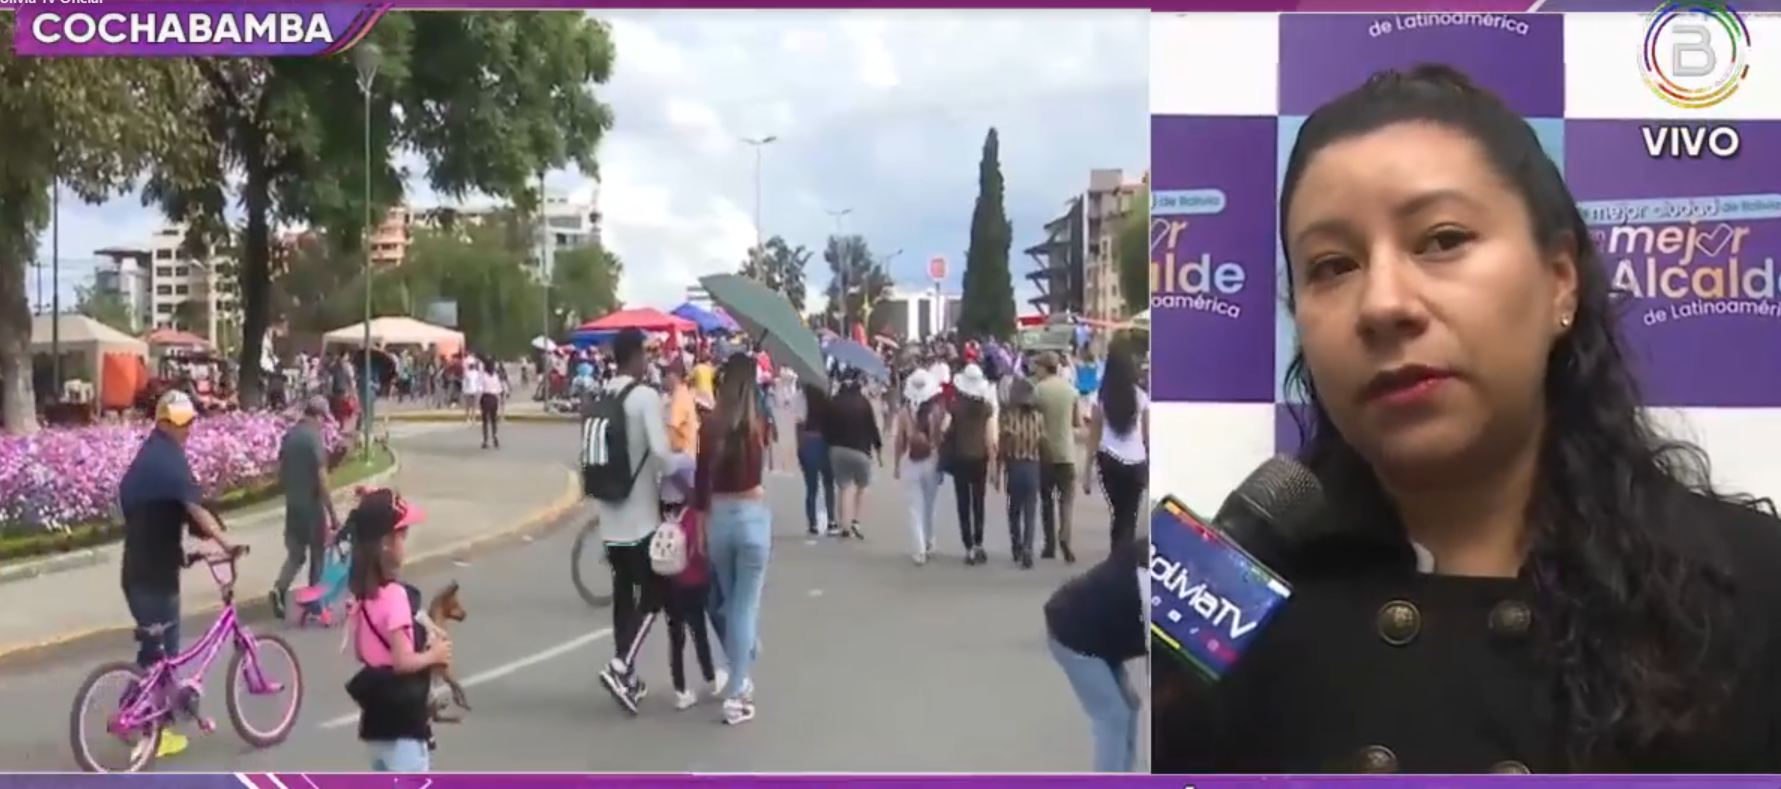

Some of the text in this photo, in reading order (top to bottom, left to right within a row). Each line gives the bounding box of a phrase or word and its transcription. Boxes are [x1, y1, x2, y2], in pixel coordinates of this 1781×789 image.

[1369, 20, 1392, 37] de
[1608, 257, 1781, 299] Alcald
[1643, 308, 1667, 326] de
